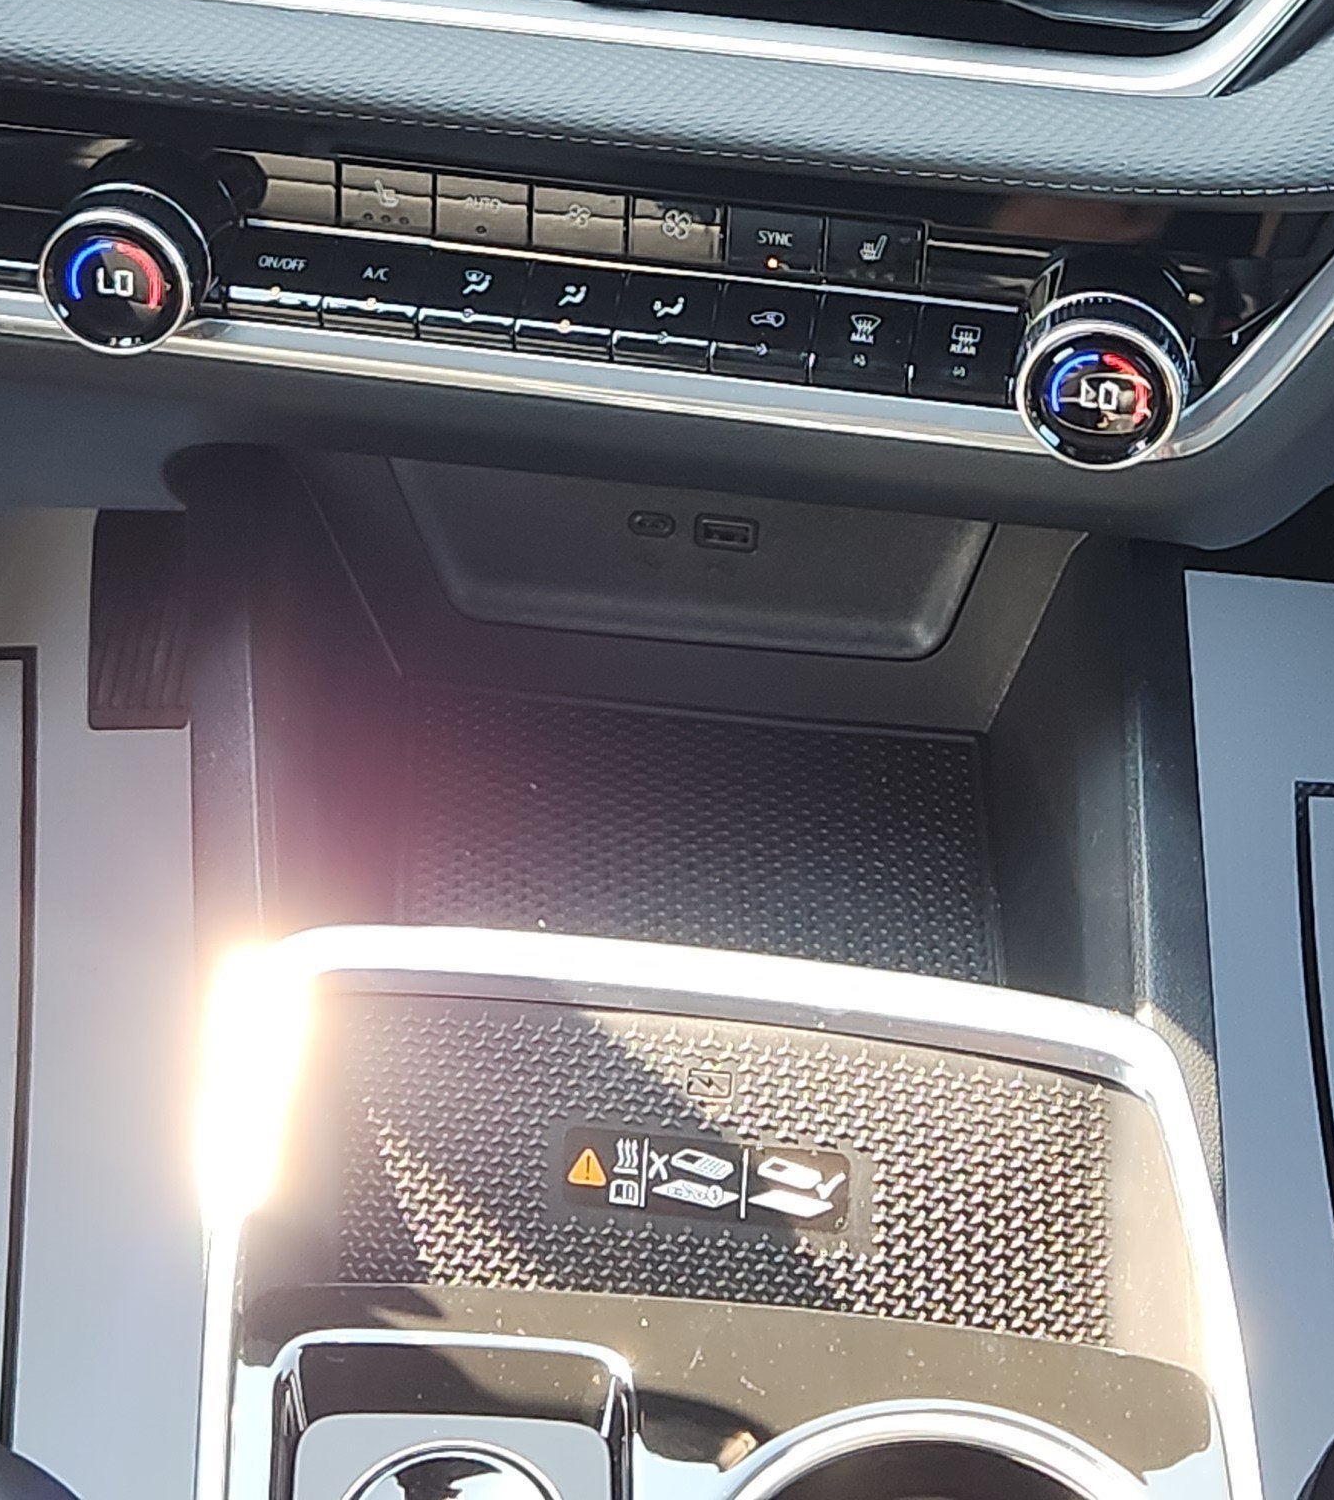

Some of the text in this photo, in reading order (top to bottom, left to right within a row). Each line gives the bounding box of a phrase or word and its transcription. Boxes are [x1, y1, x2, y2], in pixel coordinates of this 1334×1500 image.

[465, 196, 502, 212] AUTO
[757, 230, 793, 247] SYNC
[258, 255, 308, 272] ON/OFF
[362, 265, 390, 282] A/C
